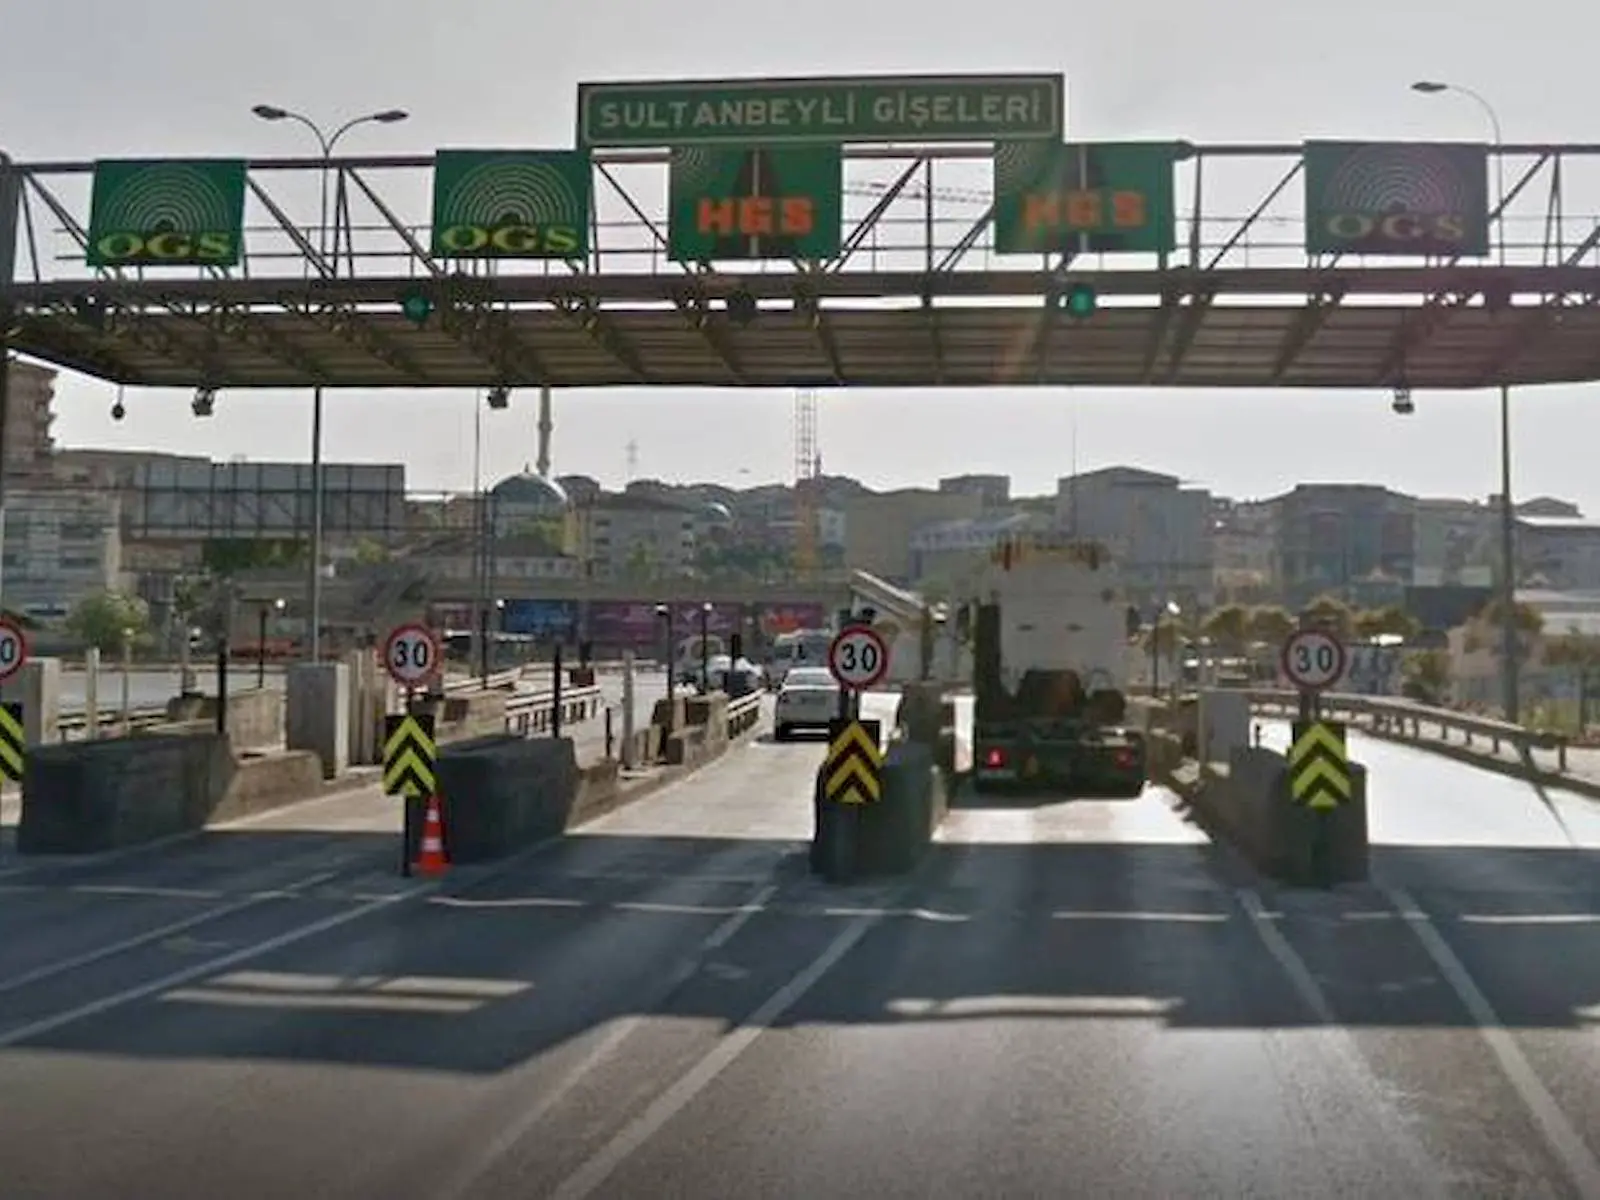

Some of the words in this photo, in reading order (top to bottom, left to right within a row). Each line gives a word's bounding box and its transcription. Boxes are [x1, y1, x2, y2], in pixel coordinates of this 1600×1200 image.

[601, 91, 855, 128] SULTANBEYLİ
[873, 89, 1040, 128] GİŞELERİ
[699, 196, 814, 235] HGS
[1022, 192, 1146, 229] HGS
[440, 224, 579, 253] OGS
[1327, 212, 1464, 241] OGS
[99, 230, 232, 261] OGS
[395, 640, 427, 667] 30
[842, 643, 876, 671] 30
[1297, 645, 1332, 672] 30
